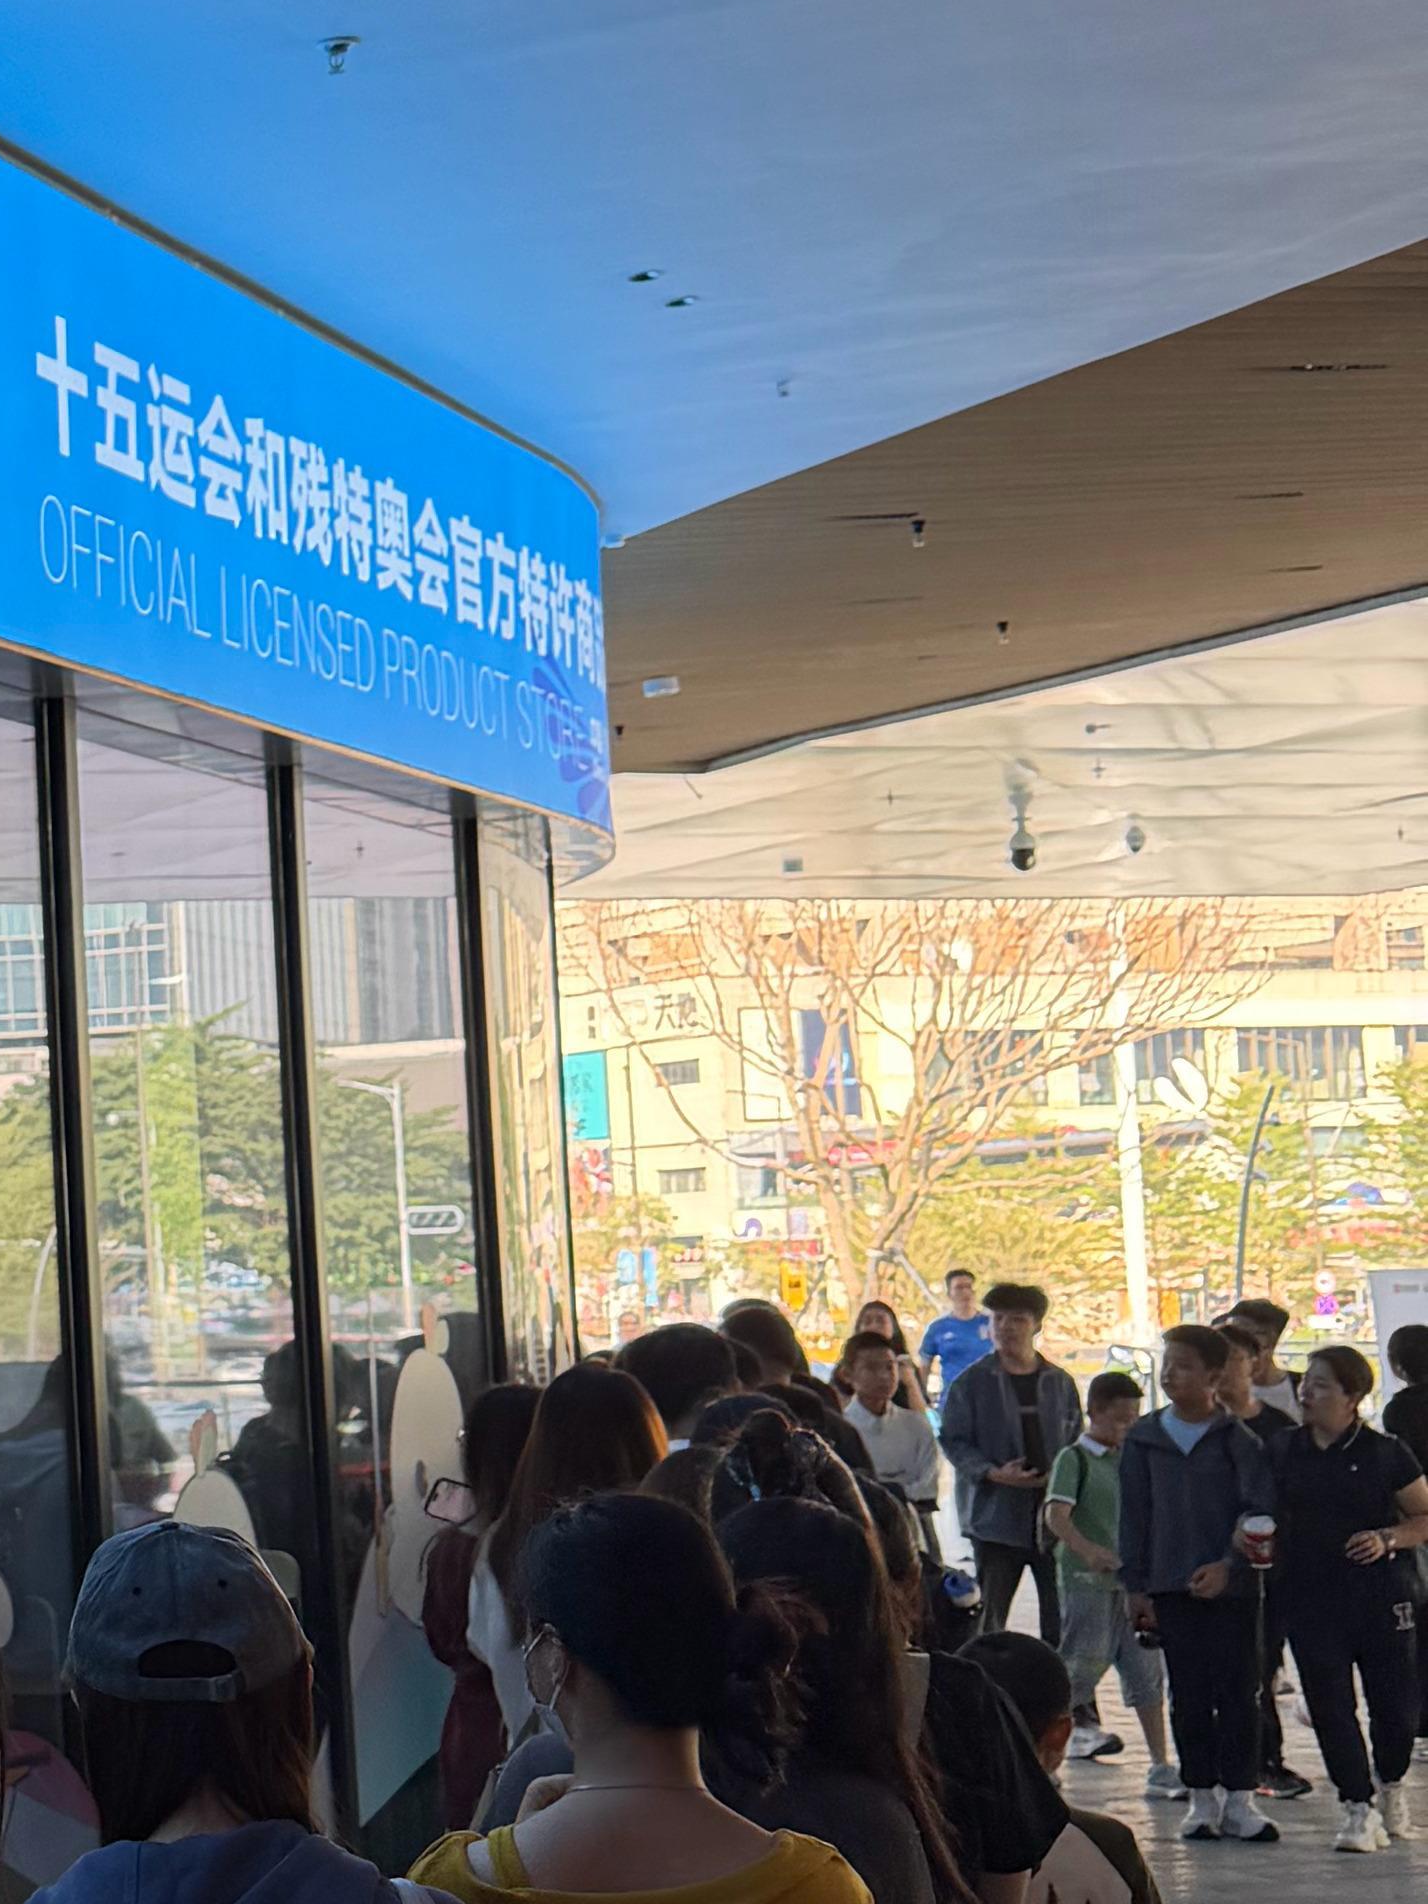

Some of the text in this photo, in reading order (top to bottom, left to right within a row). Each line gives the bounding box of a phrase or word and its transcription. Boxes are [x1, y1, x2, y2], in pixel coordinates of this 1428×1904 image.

[40, 495, 590, 771] OFFICIAL LICENSED PRODUCT STORE
